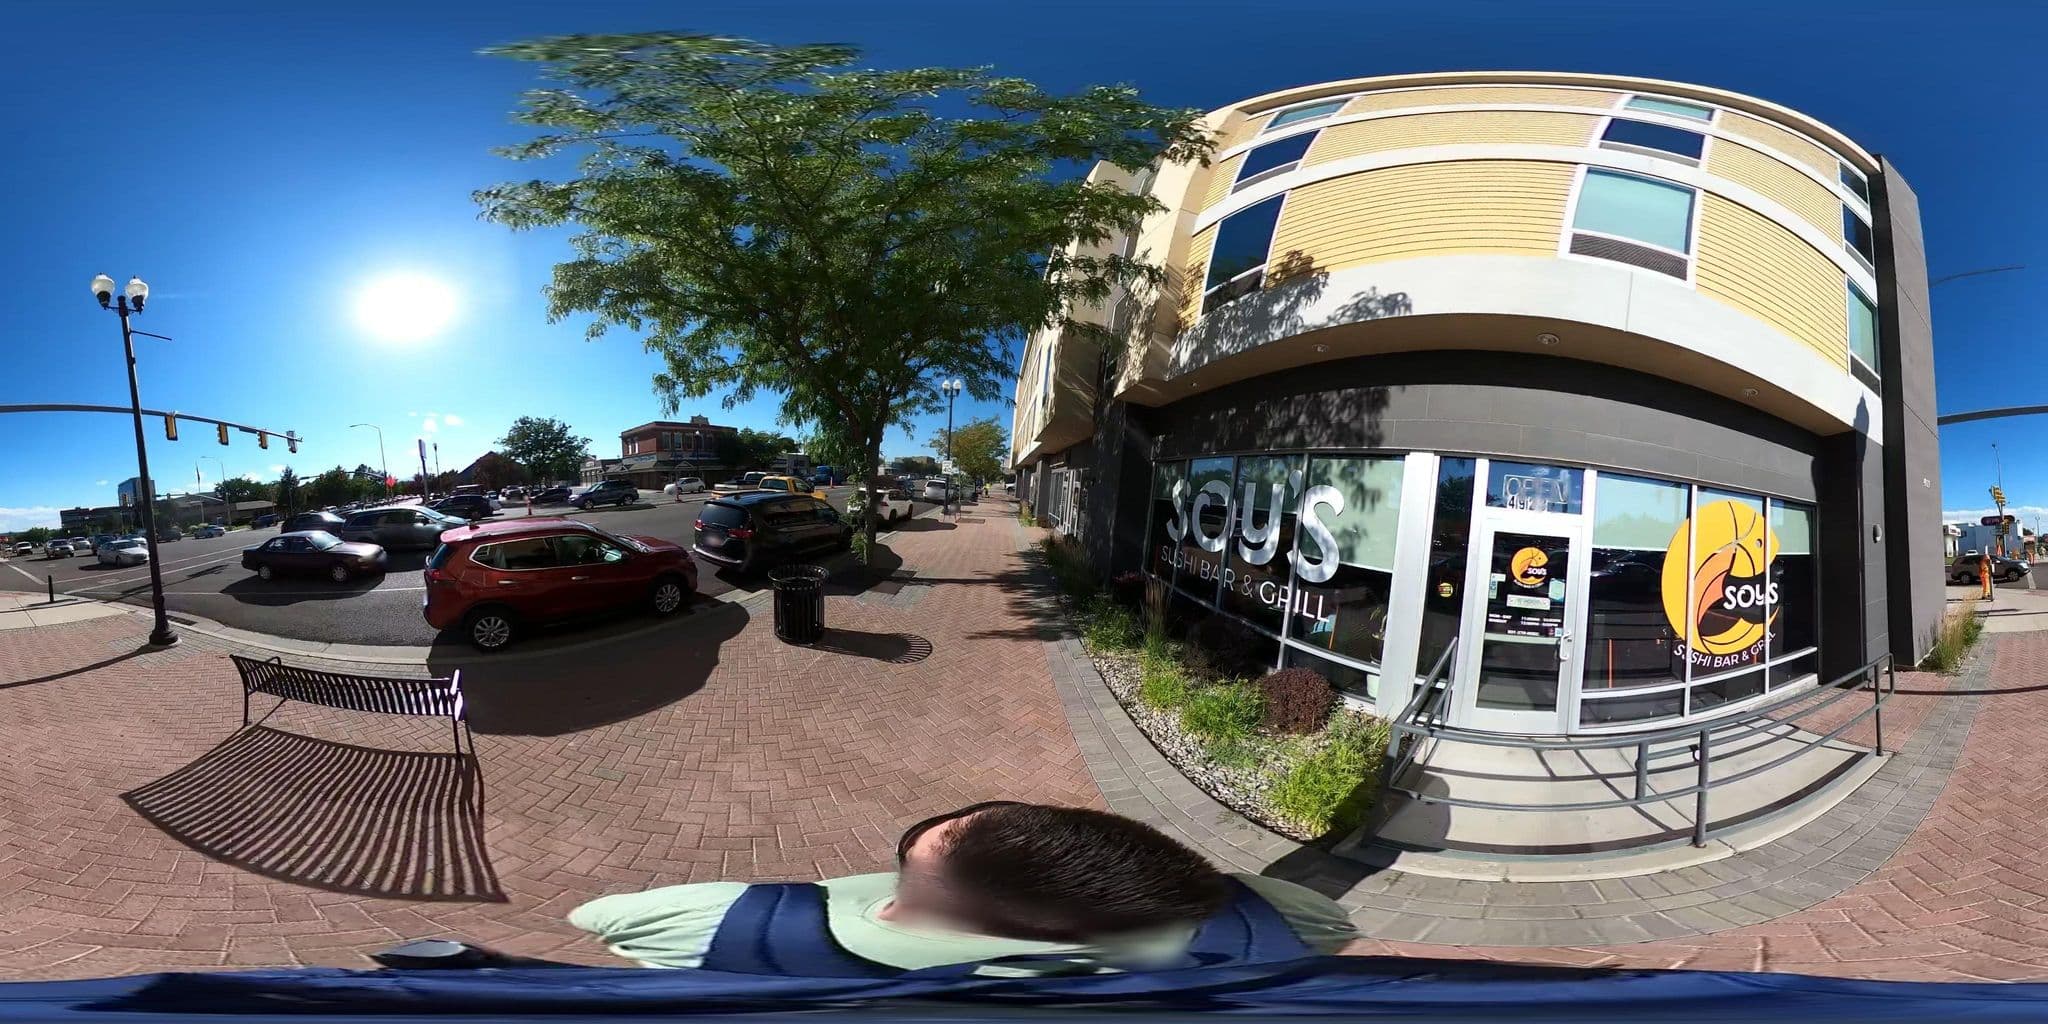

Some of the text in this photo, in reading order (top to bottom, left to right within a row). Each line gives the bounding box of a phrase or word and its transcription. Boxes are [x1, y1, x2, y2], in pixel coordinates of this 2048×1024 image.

[1506, 477, 1567, 502] OPEN
[1508, 495, 1547, 511] 492
[1161, 545, 1330, 623] SUSHI BAR & GRILL
[1713, 654, 1739, 668] BAR
[1741, 650, 1750, 661] &
